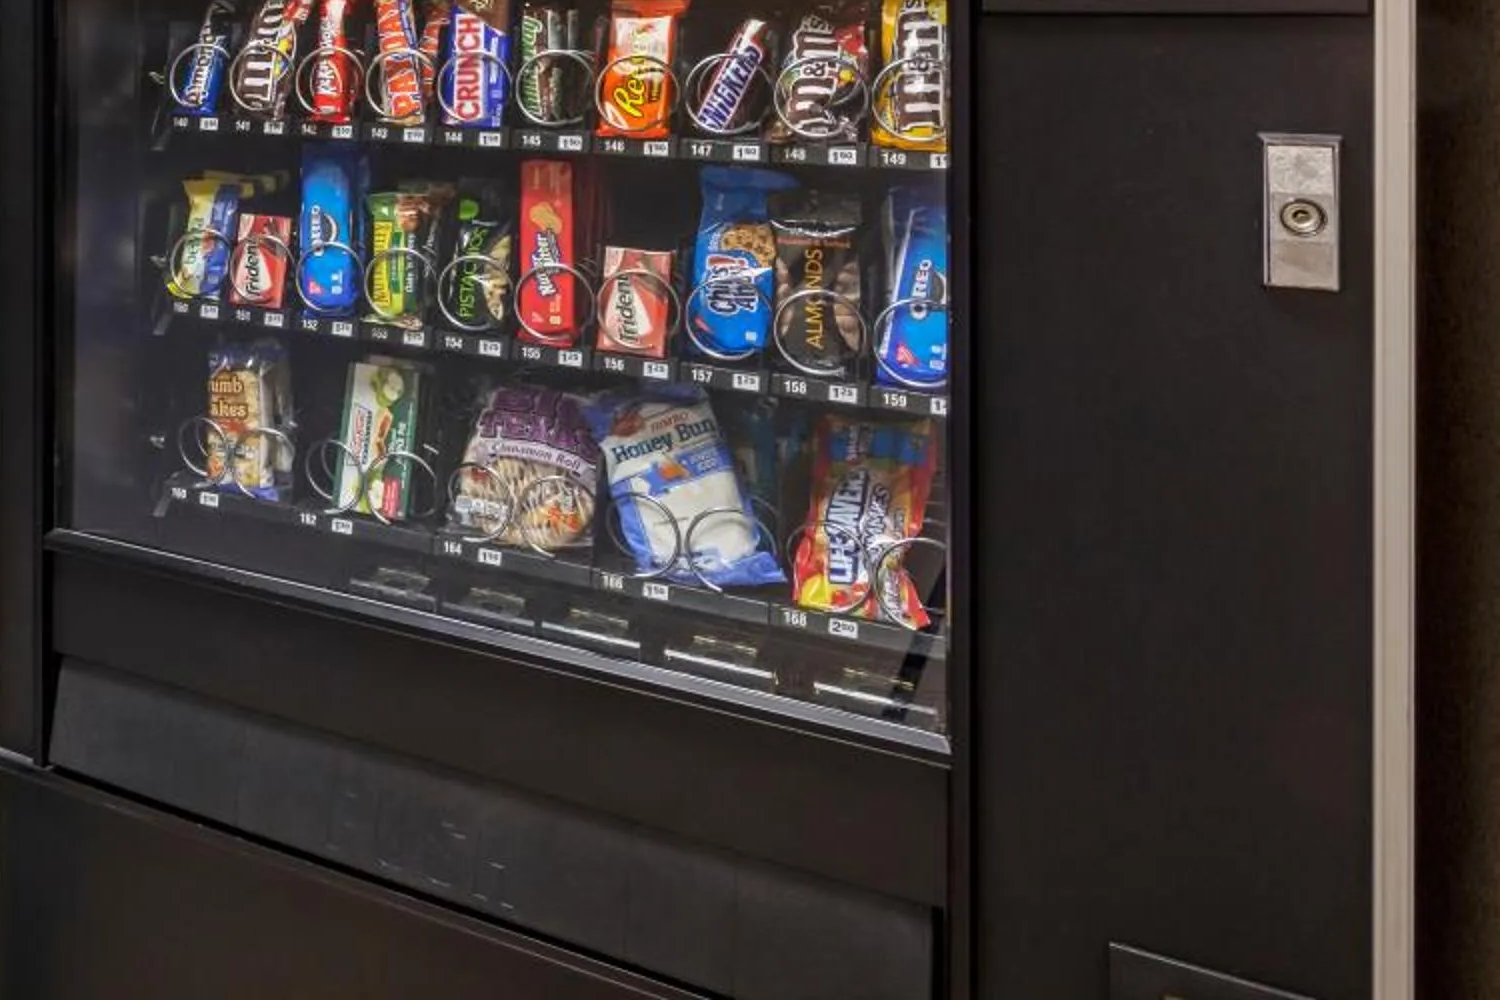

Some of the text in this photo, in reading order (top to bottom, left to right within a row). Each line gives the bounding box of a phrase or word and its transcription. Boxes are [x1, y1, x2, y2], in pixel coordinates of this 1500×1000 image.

[456, 15, 482, 121] CRUNCH
[698, 44, 762, 130] SNICKERS
[881, 151, 906, 165] 149
[691, 369, 713, 383] 157
[784, 380, 808, 395] 158
[882, 392, 907, 407] 159
[611, 431, 674, 465] Honey
[676, 418, 717, 442] Bun
[491, 443, 582, 473] Cinnamon Roll
